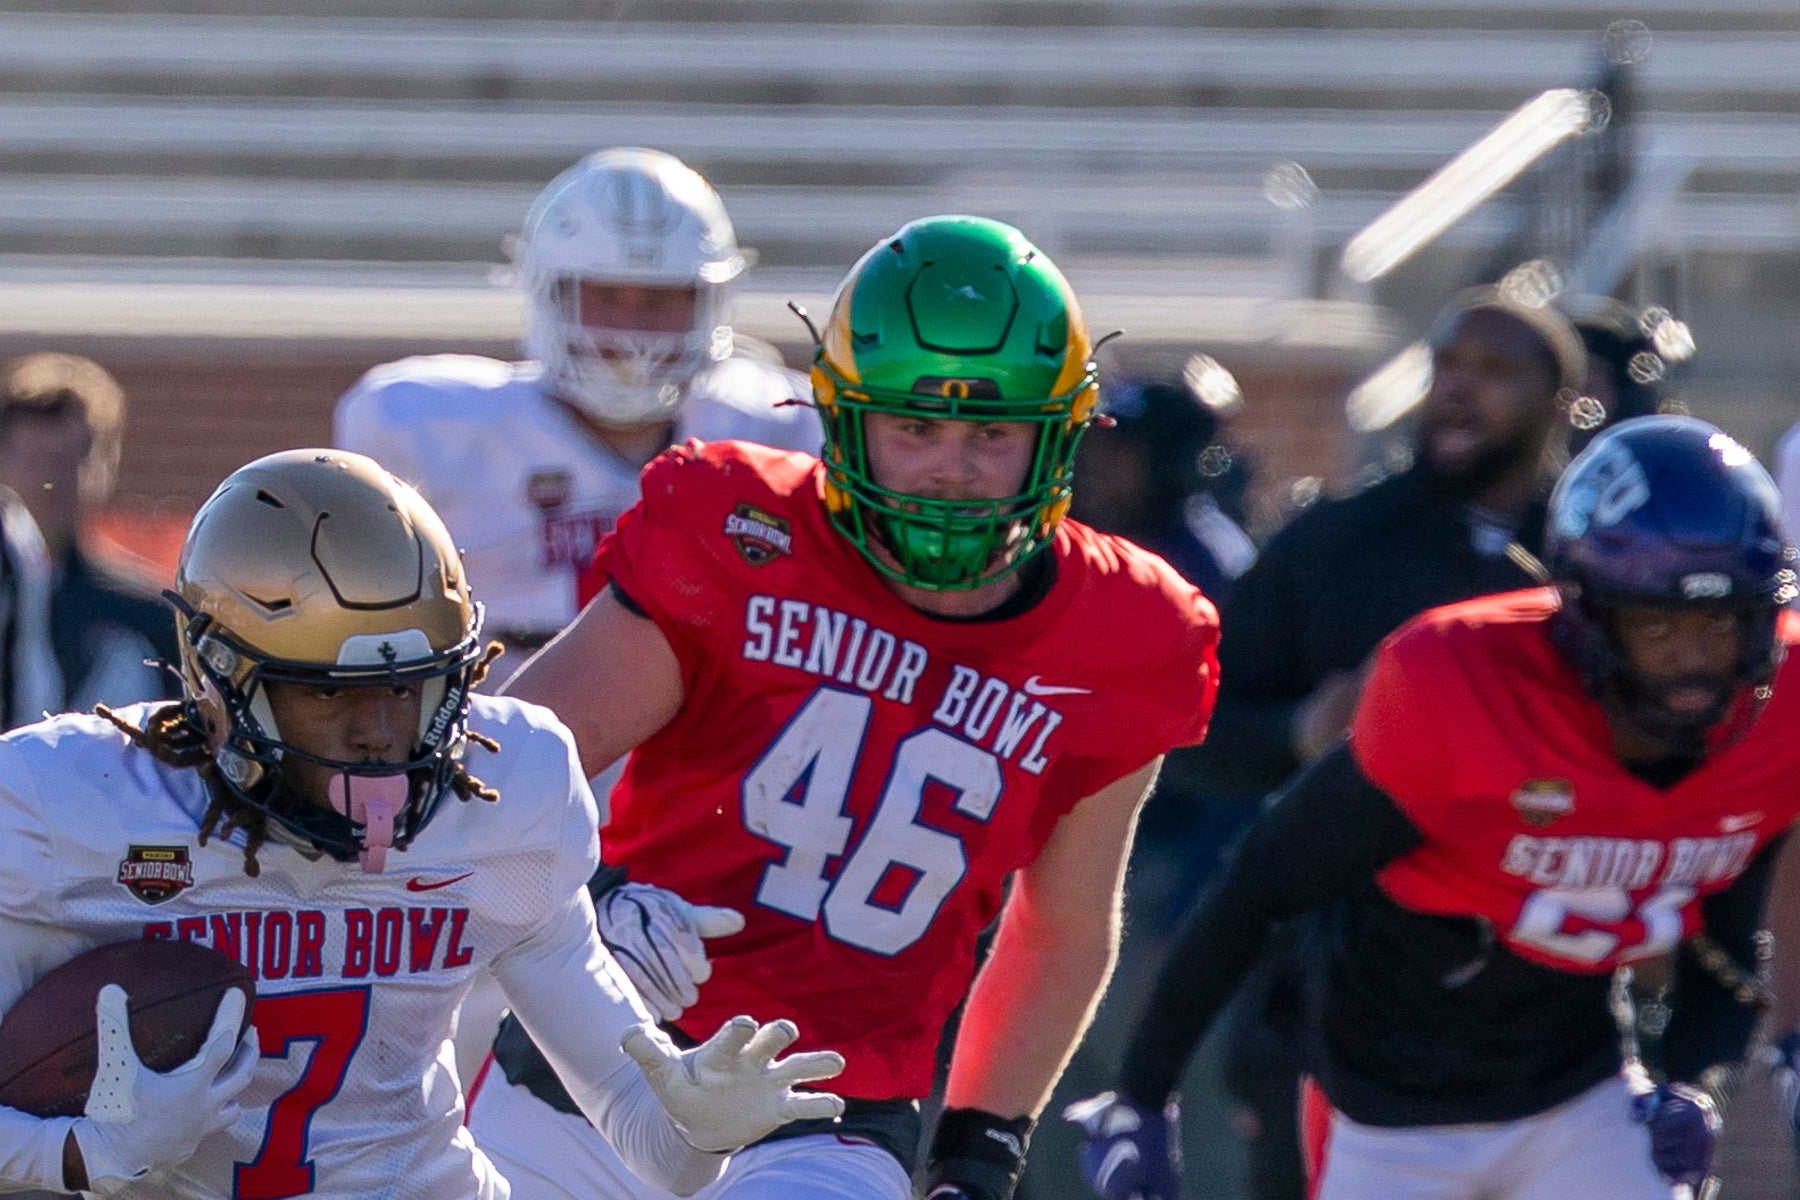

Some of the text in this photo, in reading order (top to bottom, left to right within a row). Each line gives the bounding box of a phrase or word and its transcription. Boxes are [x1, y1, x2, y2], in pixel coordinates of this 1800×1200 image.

[424, 687, 461, 746] Riddell
[742, 593, 1064, 776] SENIOR BOWL
[741, 681, 1005, 958] 46
[120, 861, 192, 884] SENIOR BOWL
[1501, 833, 1664, 890] SENIOR
[143, 907, 475, 981] NIOR BOWL
